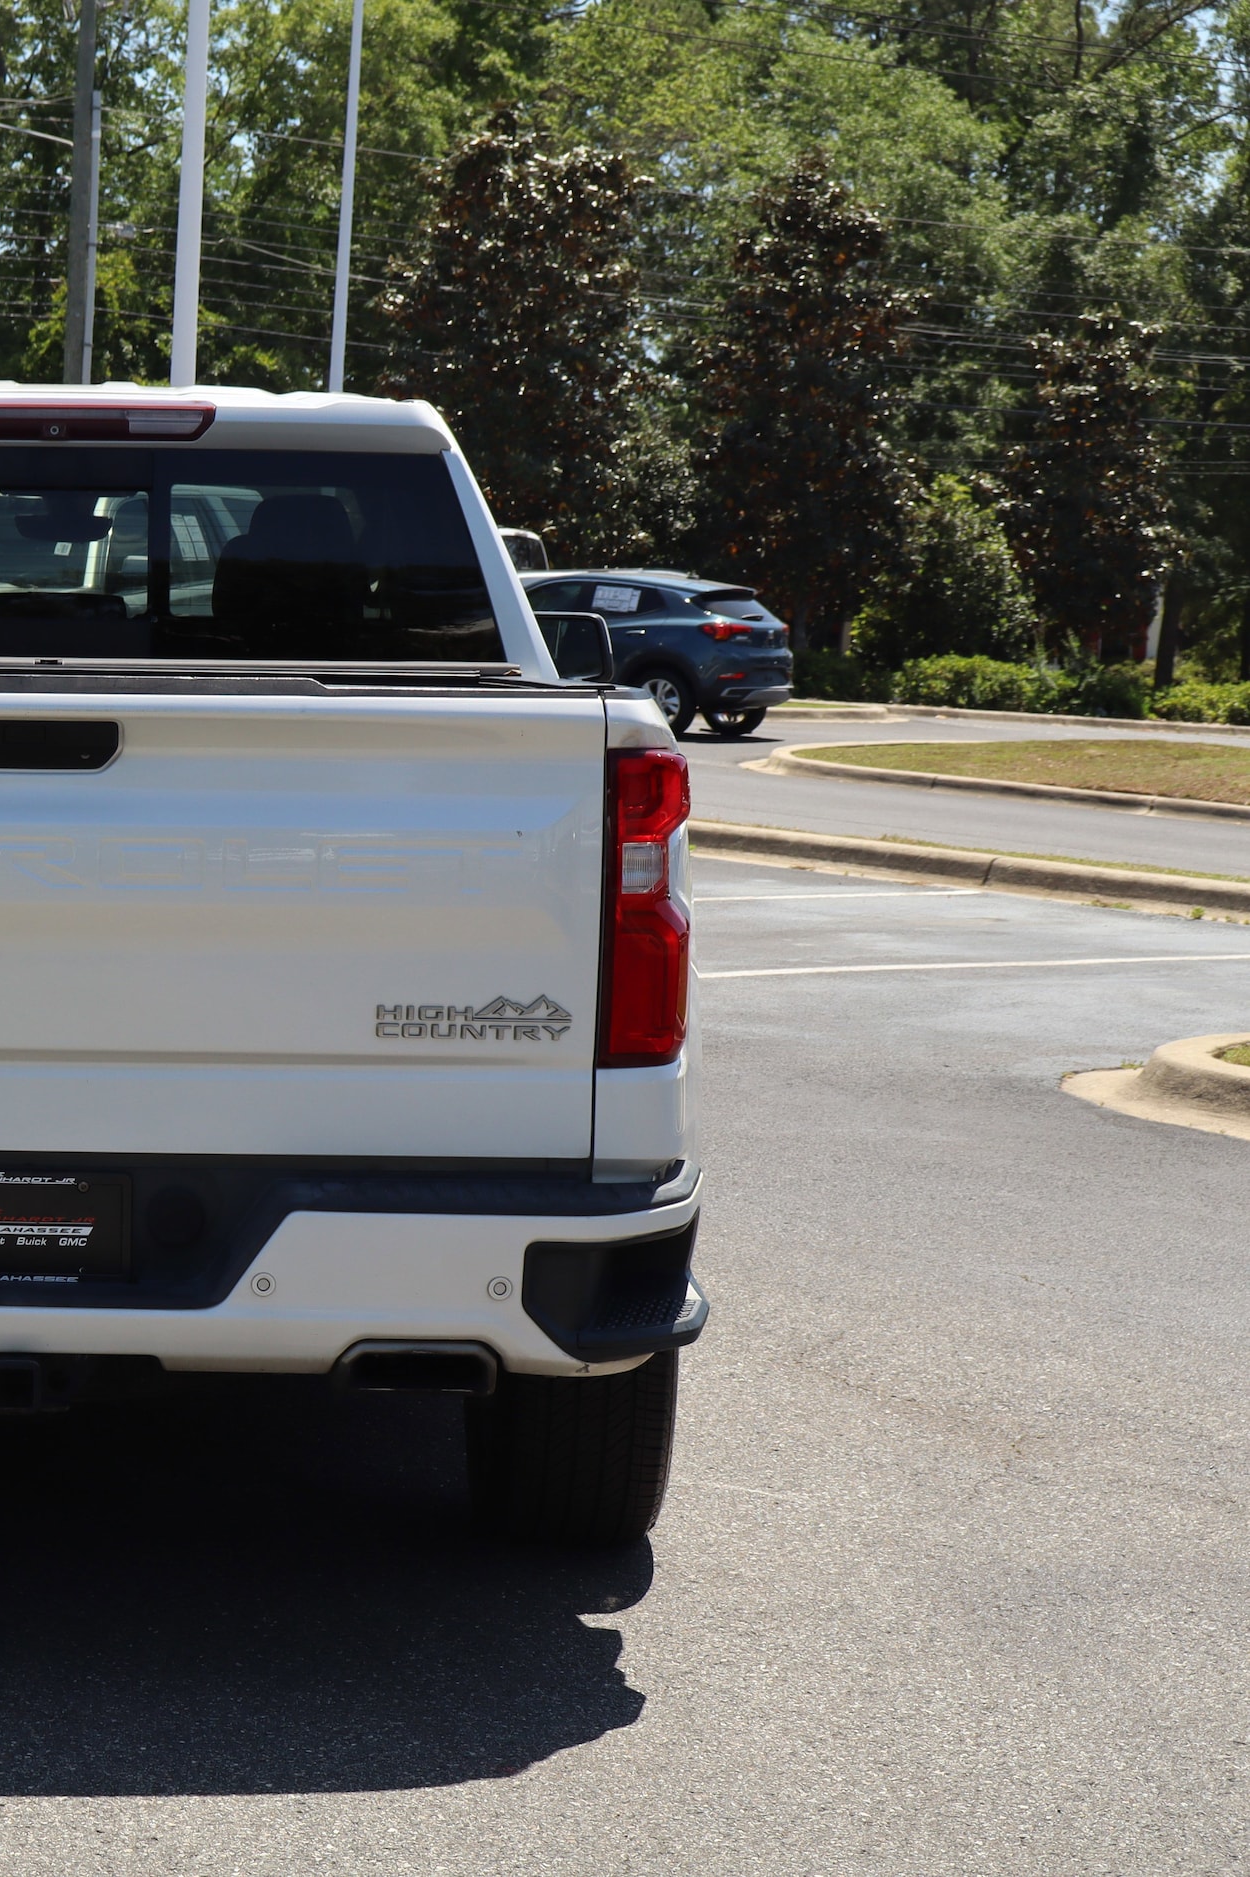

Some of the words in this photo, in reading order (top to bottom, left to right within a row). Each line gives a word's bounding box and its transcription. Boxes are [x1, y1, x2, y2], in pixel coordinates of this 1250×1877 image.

[376, 1004, 475, 1021] HIGH
[375, 1022, 571, 1041] COUNTRY
[16, 1237, 47, 1246] Buick
[58, 1237, 87, 1247] GMC
